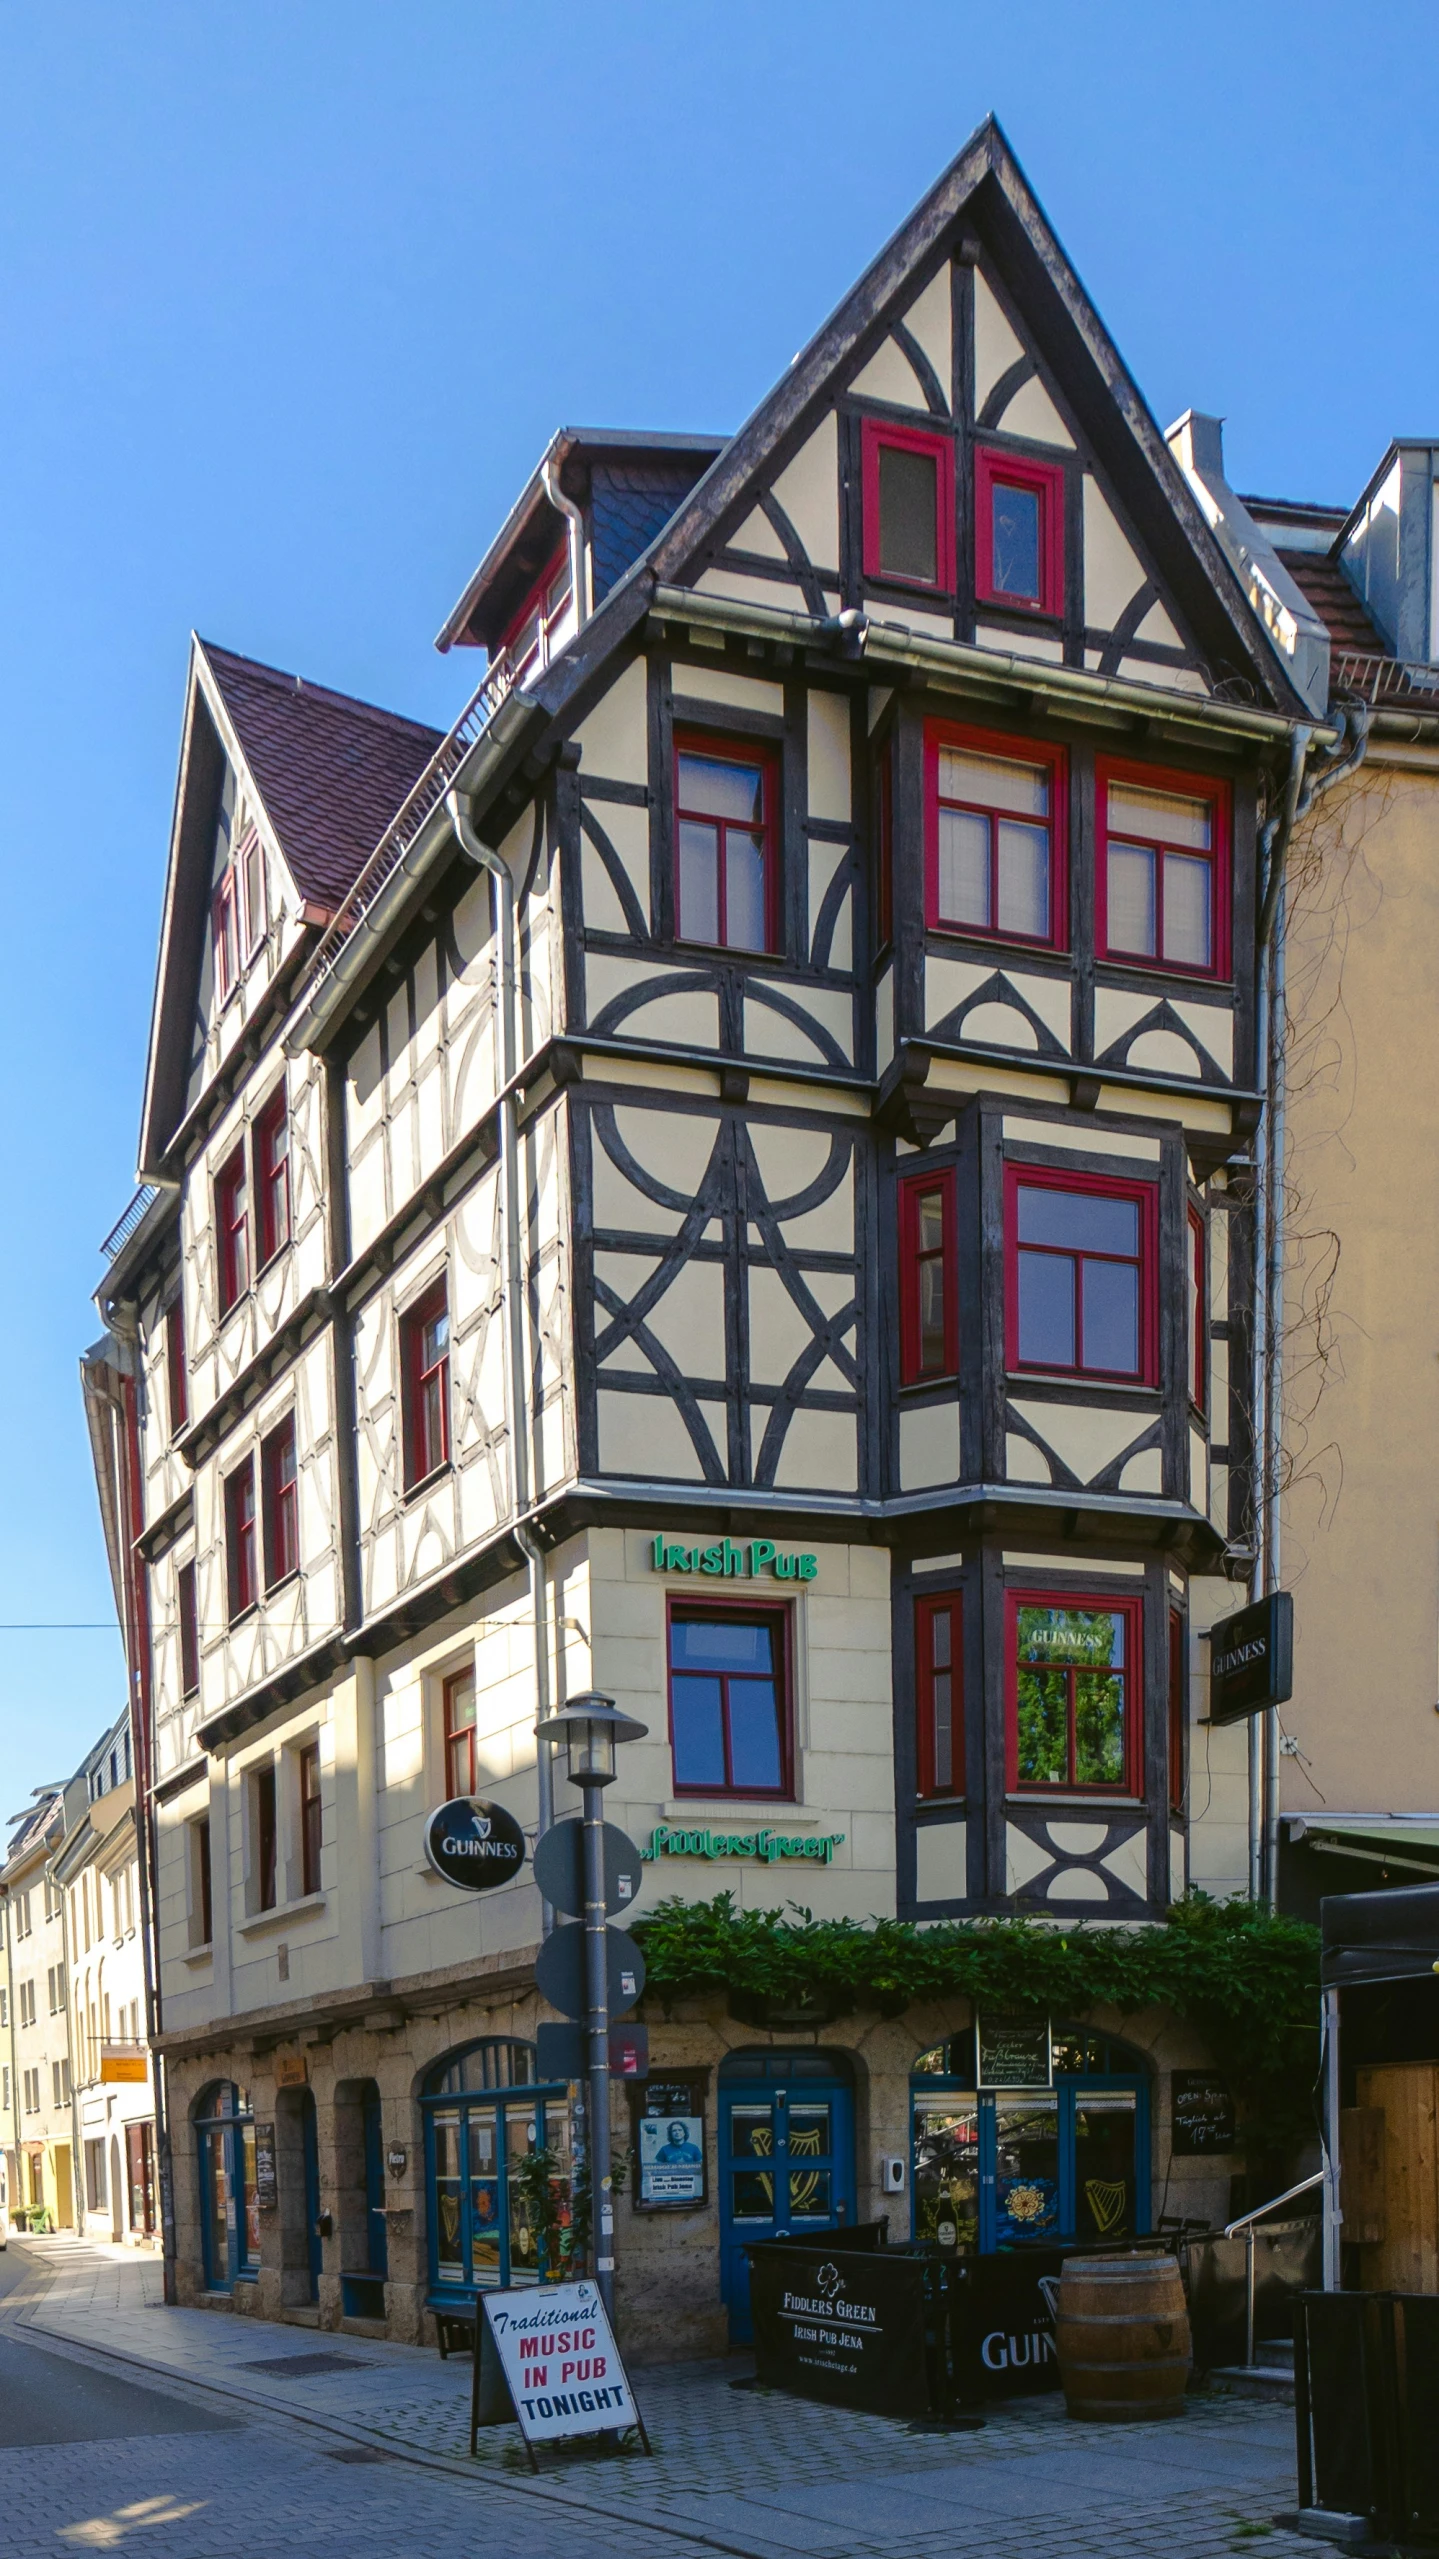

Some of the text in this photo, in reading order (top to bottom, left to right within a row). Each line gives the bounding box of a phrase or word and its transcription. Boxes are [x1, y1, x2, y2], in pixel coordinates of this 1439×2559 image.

[1032, 1629, 1103, 1647] GUINNESS
[1213, 1637, 1266, 1676] GUINNESS
[442, 1836, 518, 1858] GUINNESS
[493, 2299, 599, 2335] Traditional
[783, 2292, 876, 2322] FIDDLERS GREEN
[519, 2327, 596, 2360] MUSIC
[793, 2324, 864, 2351] IRISH PUB JENA
[981, 2331, 1058, 2370] GUIN
[524, 2356, 607, 2389] IN PUB
[521, 2385, 625, 2421] TONIGHT
